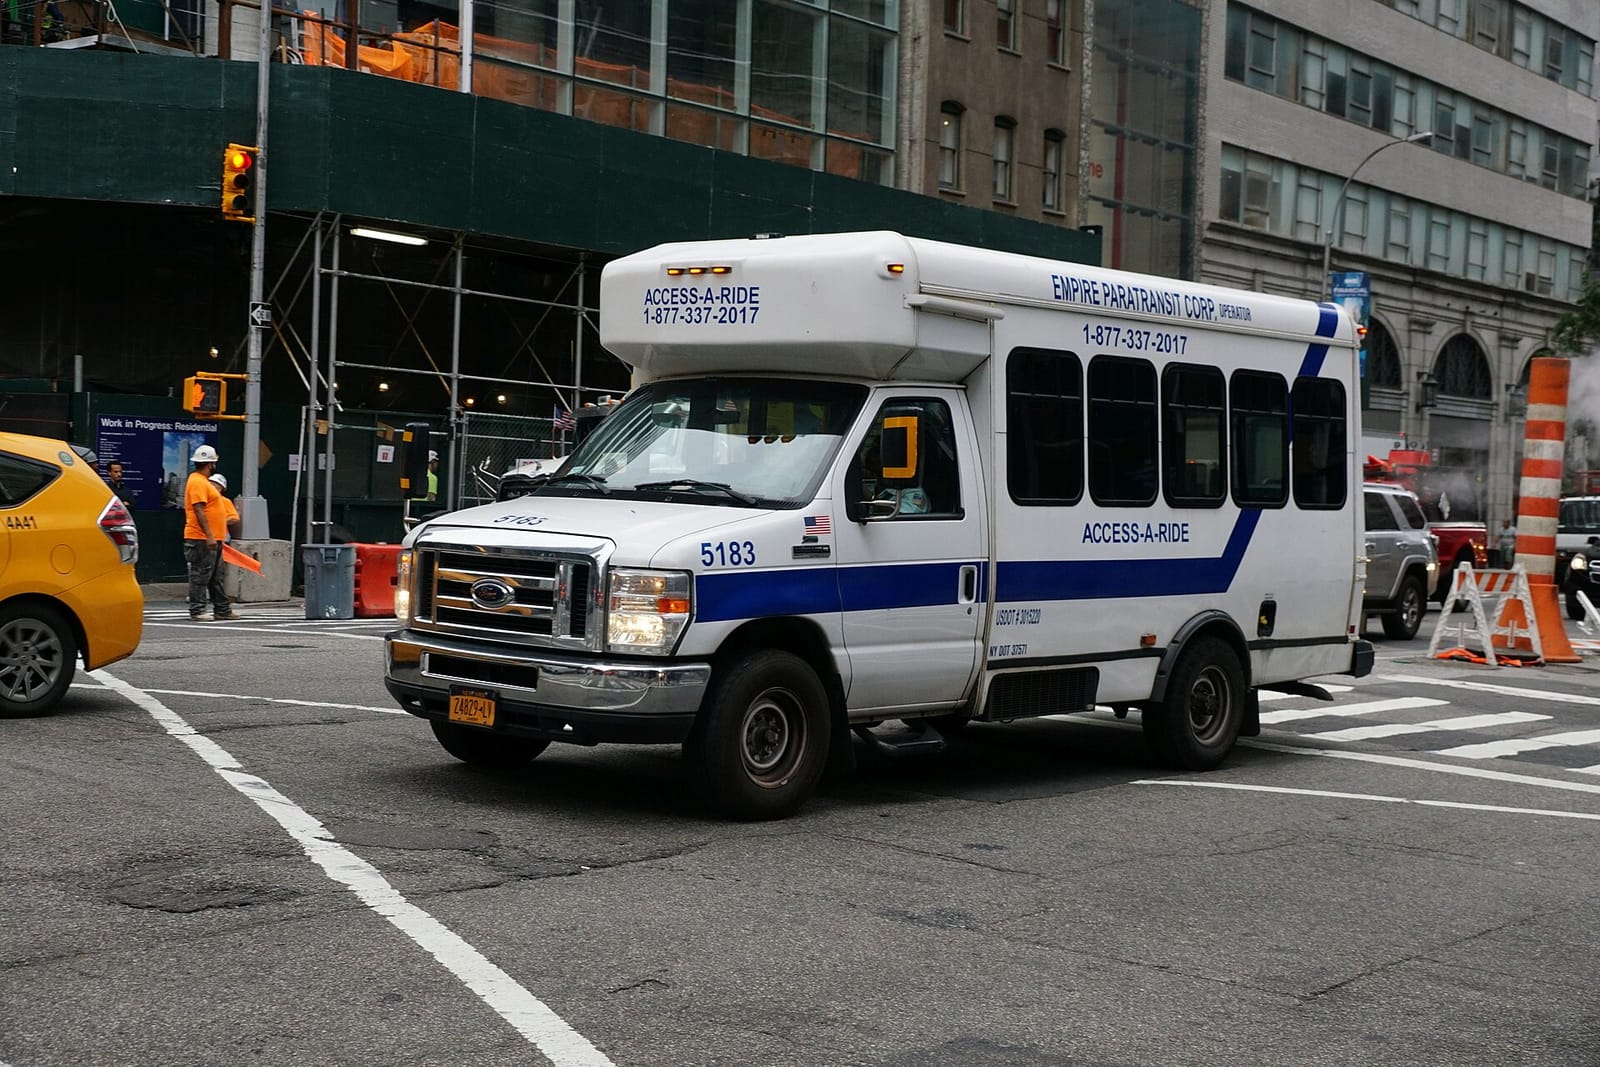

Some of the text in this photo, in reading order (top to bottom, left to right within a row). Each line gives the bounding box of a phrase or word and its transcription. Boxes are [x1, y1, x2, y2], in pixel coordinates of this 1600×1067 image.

[644, 286, 760, 305] ACCESS-A-RIDE
[1051, 274, 1100, 305] EMPIRE
[1101, 282, 1182, 316] PARATRANSIT
[1219, 303, 1252, 321] OPERATOR
[643, 306, 760, 324] 1-877-337-2017
[1083, 323, 1188, 355] 1-877-337-2017
[101, 418, 217, 432] Work in Progress: Residential
[7, 515, 38, 529] 4A41
[1082, 522, 1190, 543] ACCESS-A-RIDE
[701, 541, 756, 567] 5183
[996, 609, 1015, 625] USDOT
[990, 646, 998, 656] NY
[999, 645, 1011, 656] DOT
